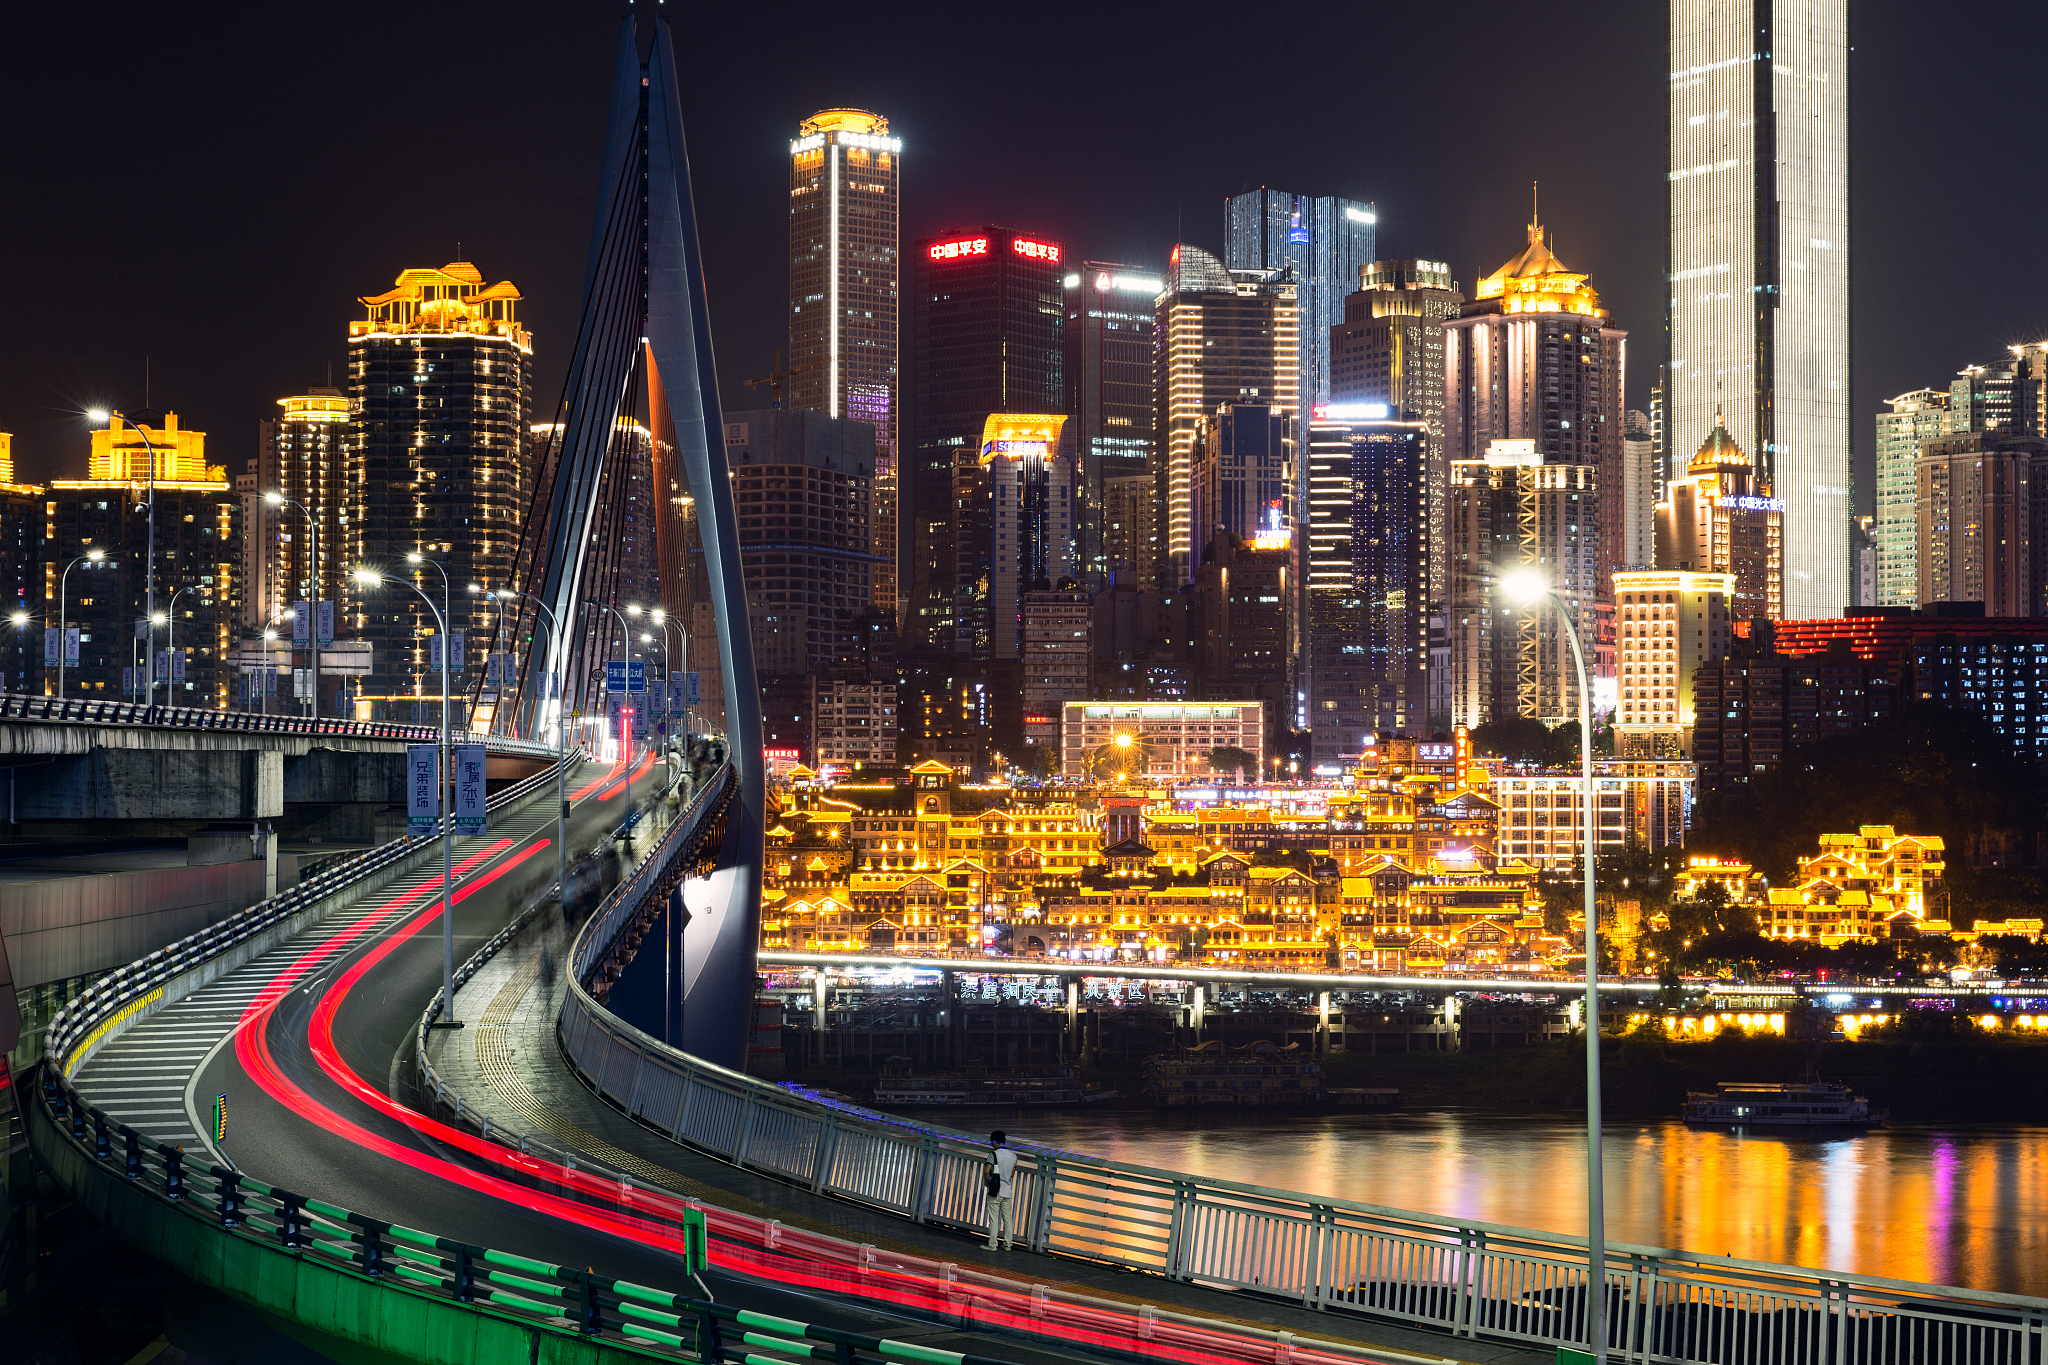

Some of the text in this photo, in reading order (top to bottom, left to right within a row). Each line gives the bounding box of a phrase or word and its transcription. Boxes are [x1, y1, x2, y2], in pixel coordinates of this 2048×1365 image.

[930, 239, 987, 260] 中国平安
[1014, 239, 1059, 262] 中国平安
[1739, 496, 1786, 512] 中国光大银行
[593, 671, 602, 679] 60
[1419, 744, 1454, 757] 洪崖洞
[416, 761, 429, 808] 兄弟装饰
[462, 761, 480, 809] 家居艺术节
